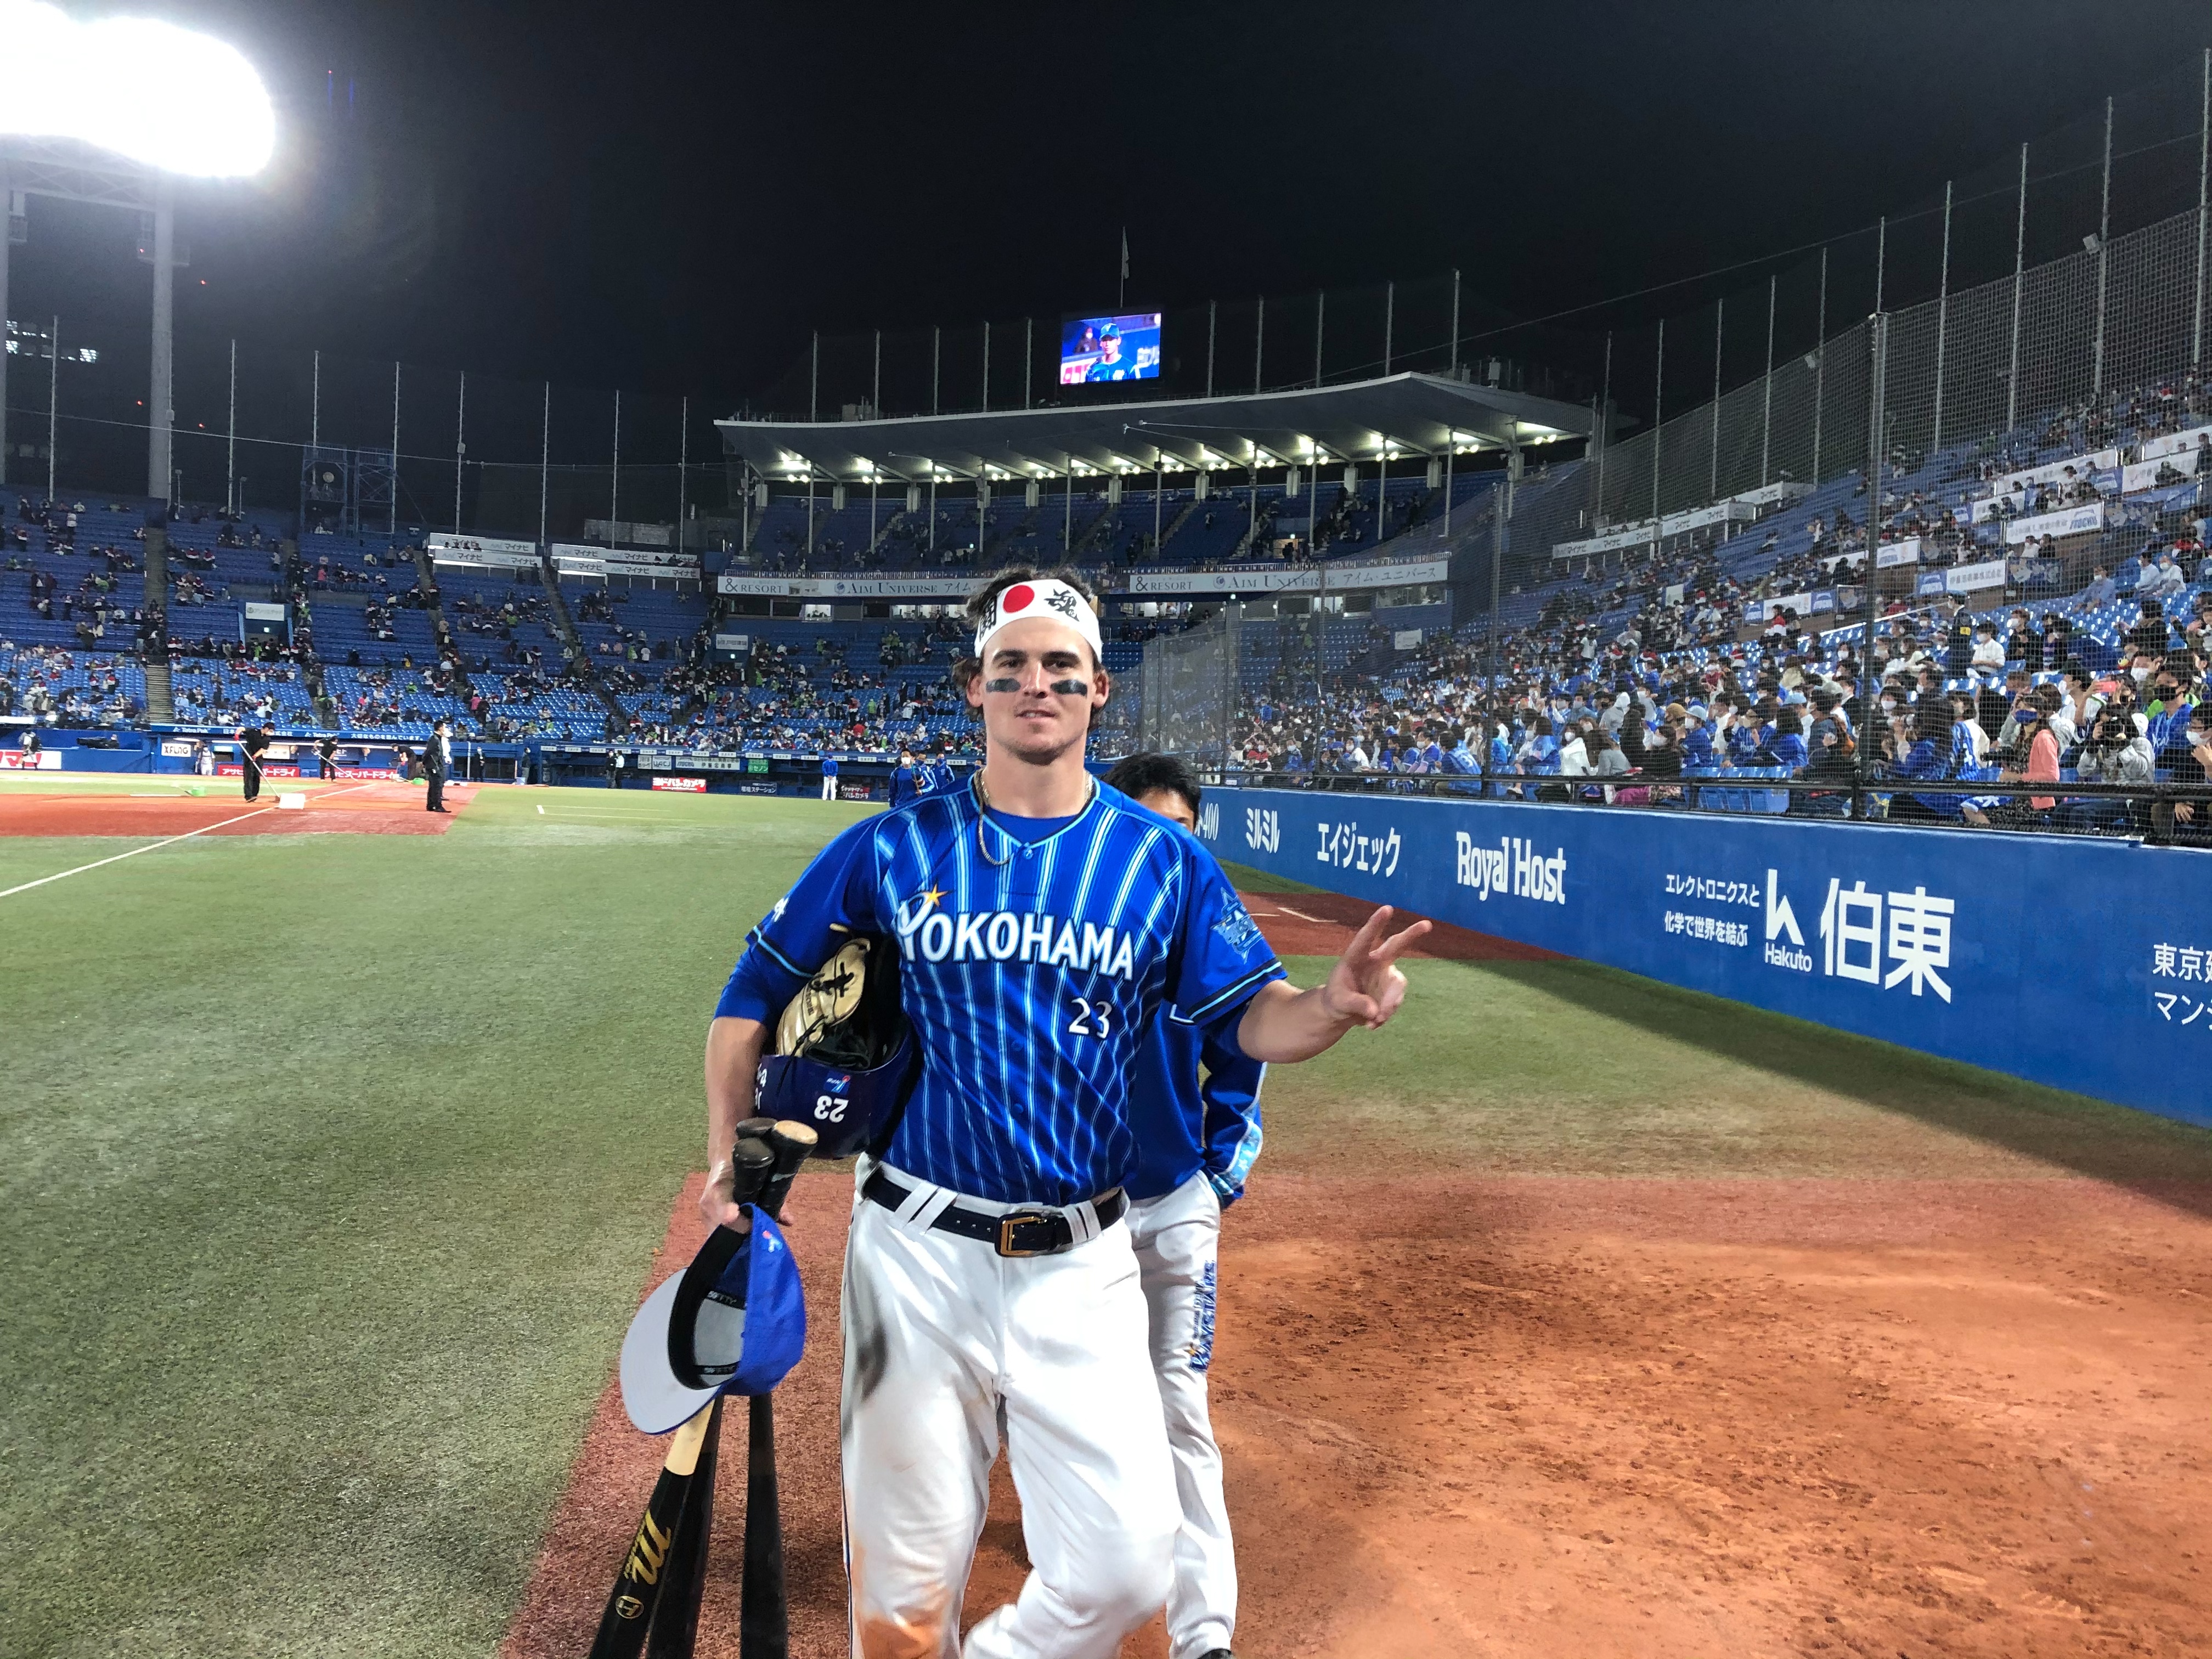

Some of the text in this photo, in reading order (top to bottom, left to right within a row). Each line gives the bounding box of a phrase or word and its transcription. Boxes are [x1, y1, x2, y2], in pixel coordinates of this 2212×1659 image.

[505, 543, 529, 551] マイナビ
[574, 549, 599, 557] マイナビ
[457, 552, 483, 561] マイナビ
[511, 557, 536, 566] マイナビ
[624, 553, 648, 561] マイナビ
[578, 562, 603, 571] マイナビ
[625, 566, 650, 574] マイナビ
[1264, 575, 1335, 588] UNIVERE
[1343, 567, 1436, 585] アイム・ユニバース
[741, 584, 782, 594] RESORT
[1152, 581, 1193, 591] RESORT
[222, 768, 296, 777] アサヒパードライ
[653, 777, 707, 787] ヨドバシカメラ
[1246, 808, 1280, 854] ミルミル
[1317, 822, 1401, 878] エイジェック
[1456, 831, 1567, 905] Royal Host
[1666, 873, 1760, 908] エレクトロニクスと
[897, 891, 1133, 981] YOKOHAMA
[1664, 910, 1748, 947] 化学で世界を結ぶ
[1819, 877, 1955, 1004] 伯東
[1764, 941, 1813, 973] Hakuto
[1068, 996, 1113, 1039] 23
[814, 1095, 849, 1123] 23
